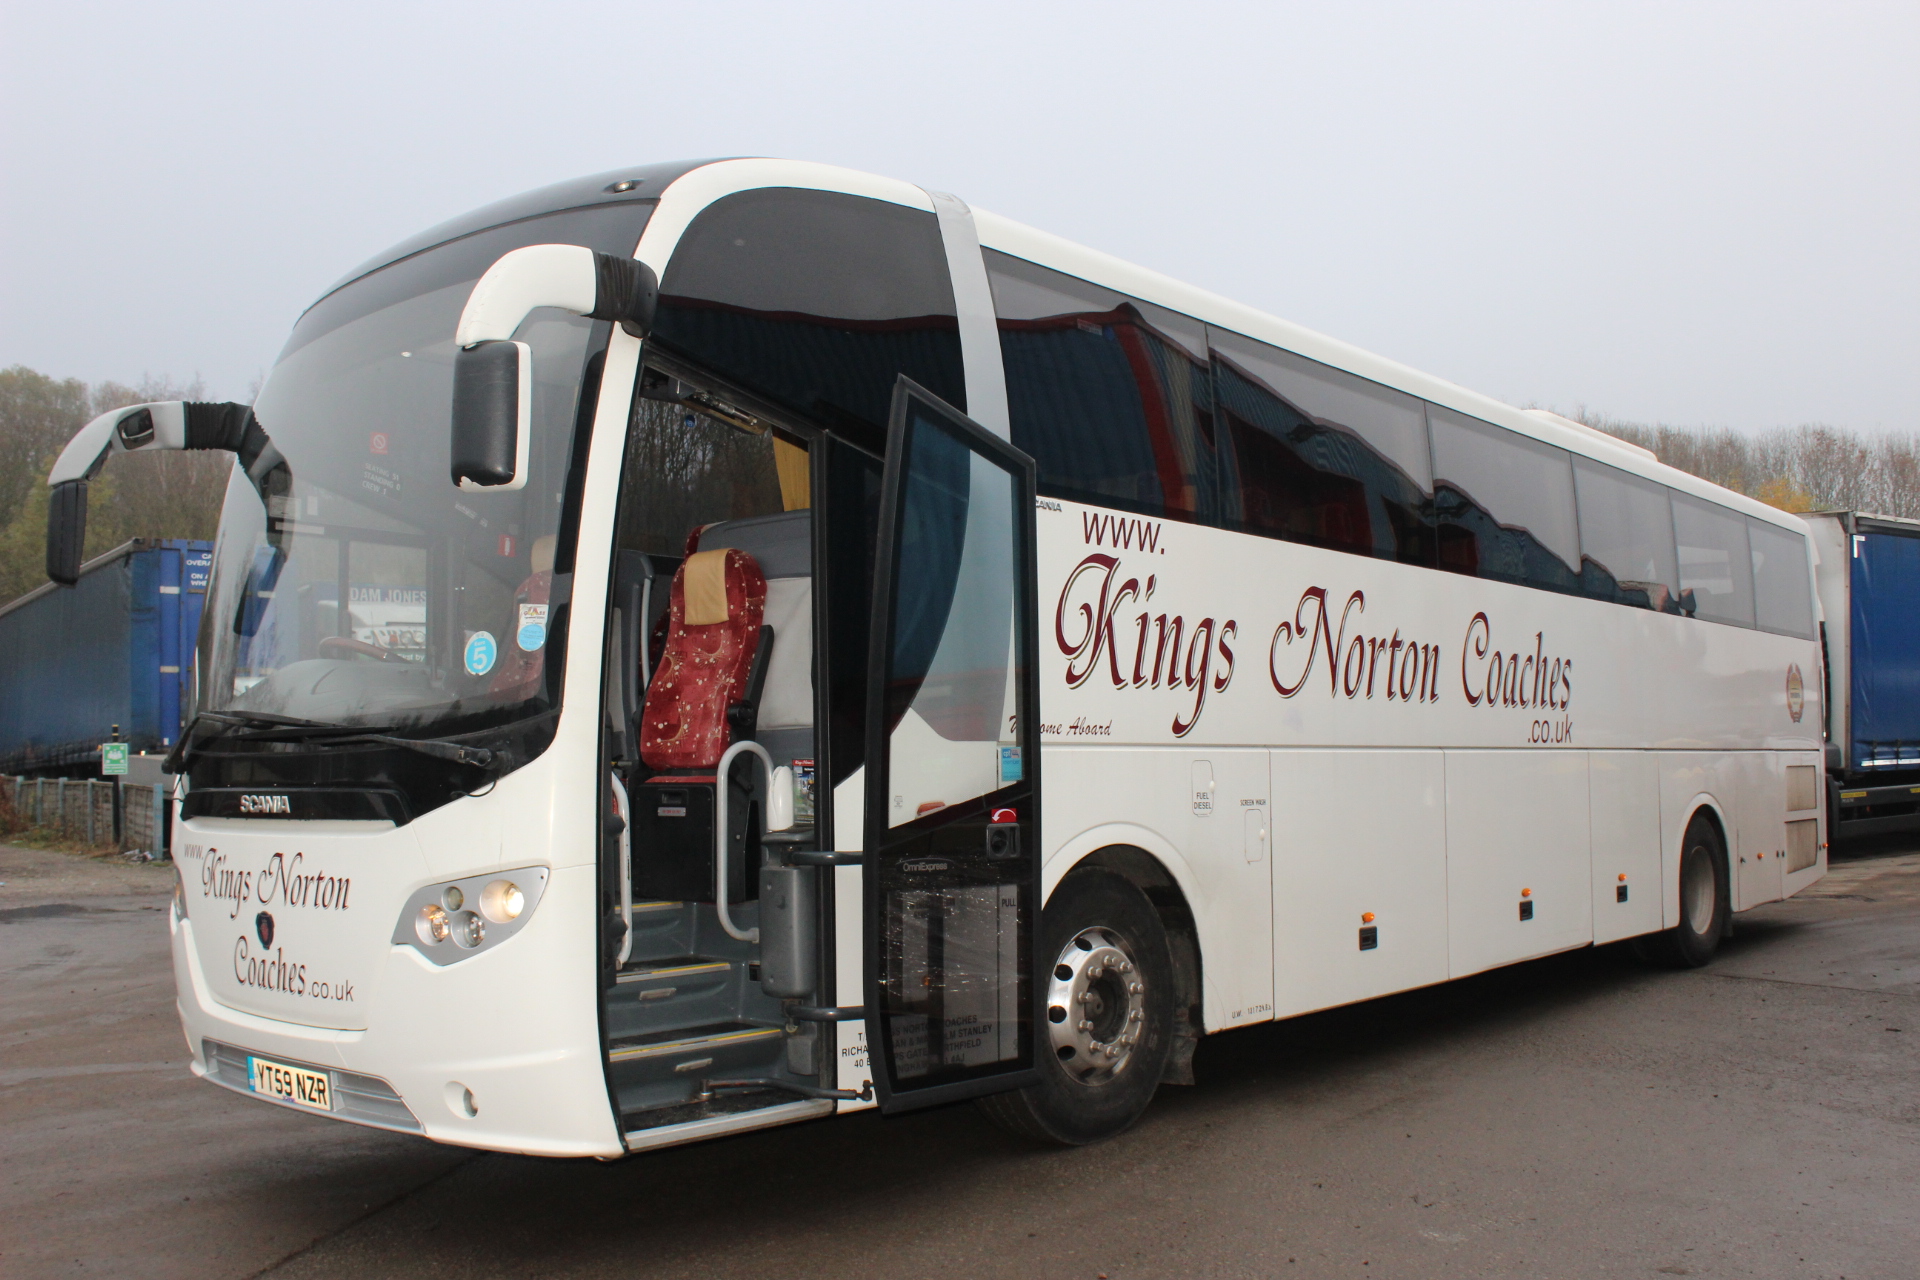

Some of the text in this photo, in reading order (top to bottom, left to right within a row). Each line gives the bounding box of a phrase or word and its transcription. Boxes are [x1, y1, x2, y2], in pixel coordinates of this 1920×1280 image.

[349, 587, 427, 603] DAM JONES
[1055, 553, 1573, 738] Kings Norton Coaches
[472, 646, 488, 670] 5
[1066, 716, 1113, 736] Aboard
[240, 794, 291, 814] SCANIA
[1193, 801, 1213, 810] DIESEL
[1196, 792, 1210, 800] FUEL
[1240, 799, 1255, 807] SCREEN
[902, 861, 948, 872] OmniExpress
[202, 847, 252, 920] Kings
[257, 852, 351, 911] Norton
[1001, 898, 1017, 907] PULL
[944, 1014, 978, 1028] OACHES
[841, 1044, 869, 1058] RICHA
[958, 1023, 993, 1039] STANLEY
[854, 1058, 864, 1068] 40
[944, 1038, 982, 1053] RTHFIELD
[256, 1063, 328, 1106] YT59 NZR
